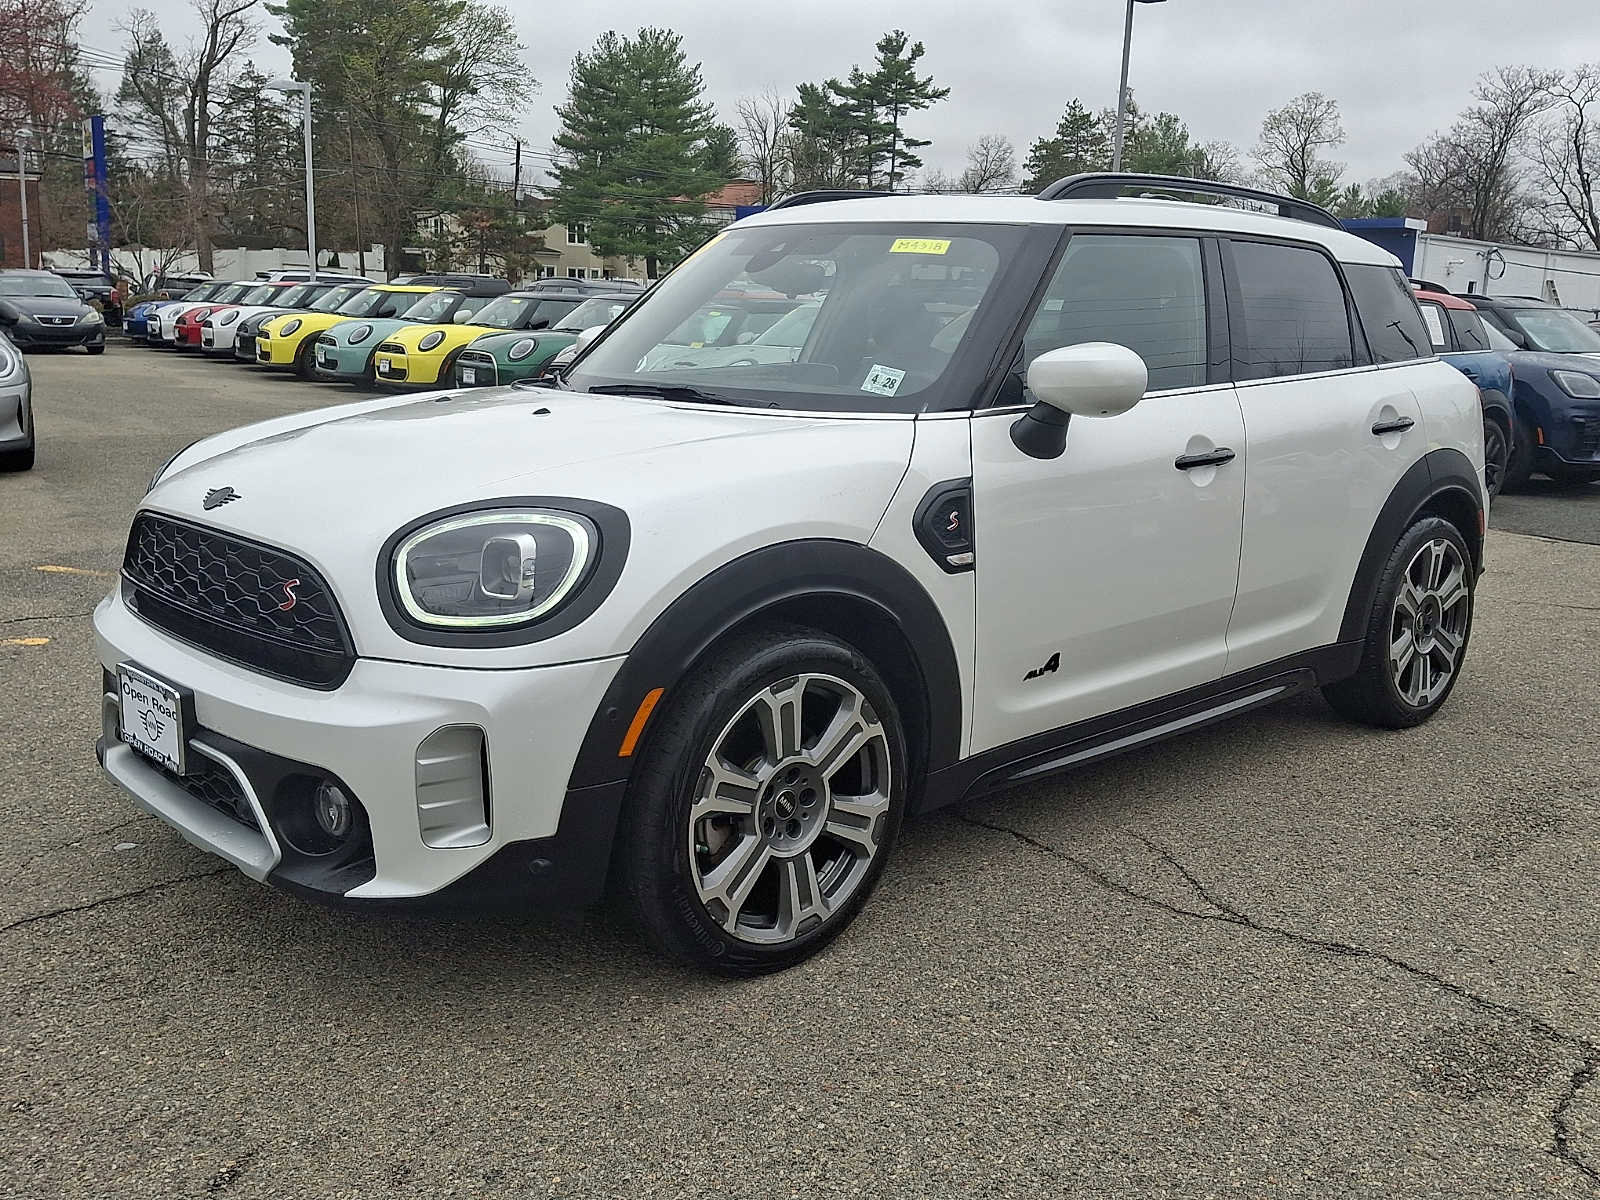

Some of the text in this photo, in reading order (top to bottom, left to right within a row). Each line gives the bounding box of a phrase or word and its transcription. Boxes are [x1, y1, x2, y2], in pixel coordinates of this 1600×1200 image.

[871, 374, 897, 389] 4 28
[947, 511, 959, 531] S
[279, 579, 300, 611] S
[123, 682, 149, 705] Open
[124, 734, 143, 750] OPEN
[144, 745, 163, 762] ROAD
[779, 795, 793, 813] MINI
